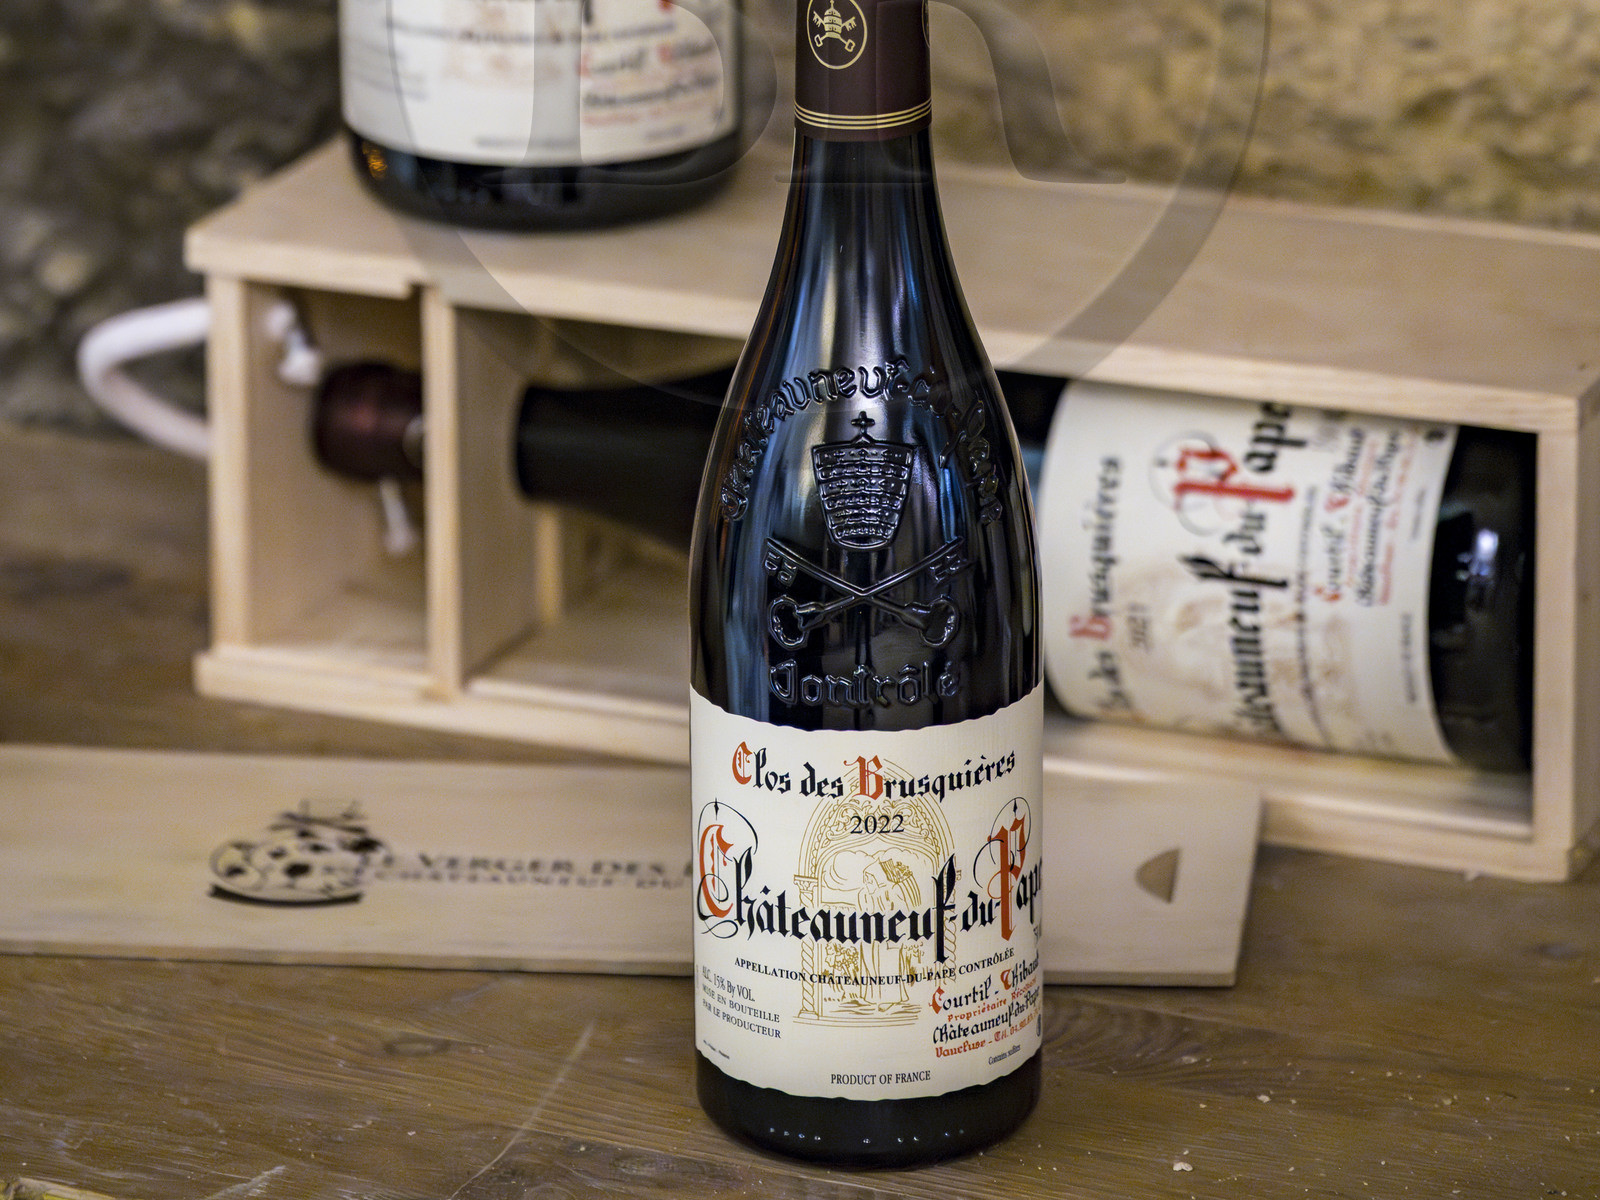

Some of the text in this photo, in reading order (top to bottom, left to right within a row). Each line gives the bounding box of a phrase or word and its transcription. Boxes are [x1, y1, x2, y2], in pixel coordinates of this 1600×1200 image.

[731, 741, 1016, 803] Clos des Brusquières
[850, 814, 904, 835] 2022
[735, 947, 1015, 987] APPELLATION CHÂTEAUNEUF-DU-PAPE CONTRÔLÉE
[714, 973, 726, 991] 15%
[727, 980, 736, 998] By
[736, 984, 756, 1002] VOL.
[928, 974, 992, 1015] Courtil
[713, 1006, 721, 1018] LE
[722, 1011, 782, 1039] PRODUCTEUR
[717, 993, 727, 1006] EN
[729, 999, 780, 1023] BOUTEILLE
[831, 1070, 931, 1086] PRODUCT OF FRANCE
